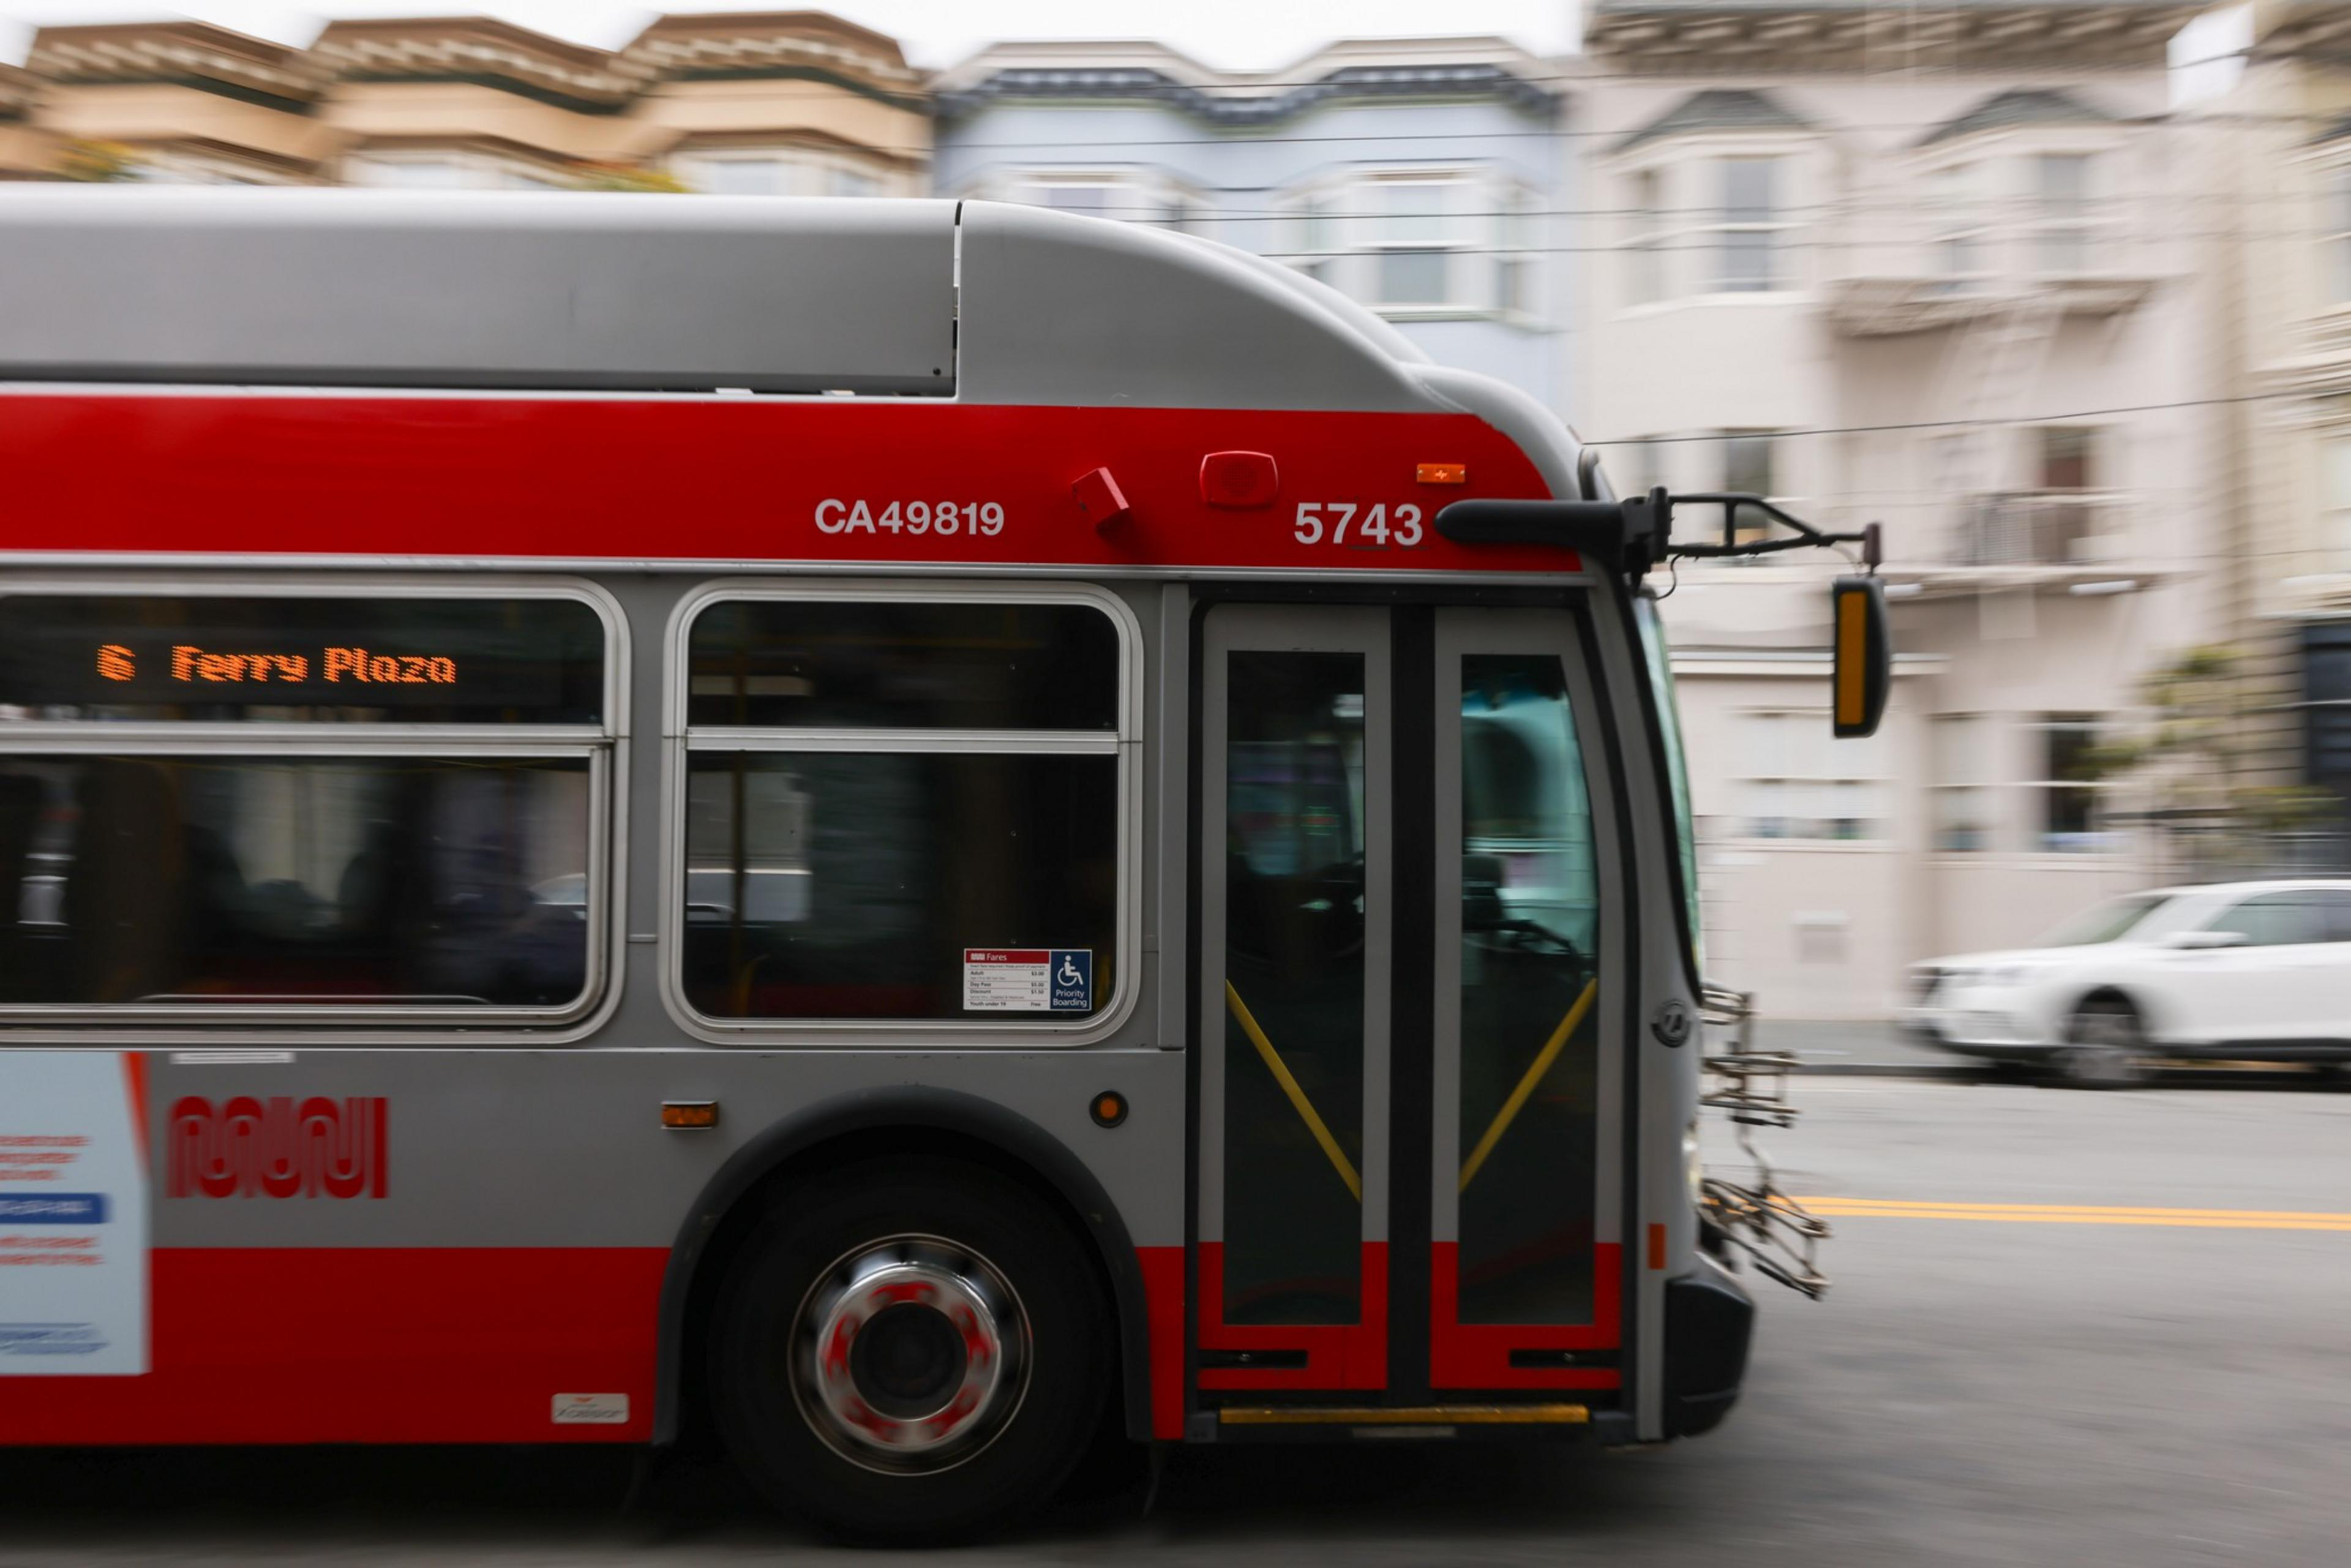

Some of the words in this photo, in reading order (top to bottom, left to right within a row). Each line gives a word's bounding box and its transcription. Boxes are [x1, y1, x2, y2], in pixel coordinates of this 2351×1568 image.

[815, 498, 1005, 536] CA49819
[1294, 502, 1423, 546] 5743
[96, 644, 136, 681] 6
[171, 645, 308, 682] Ferry
[323, 647, 456, 683] Plaza
[1053, 998, 1087, 1008] Boarding
[1056, 989, 1085, 999] Priority
